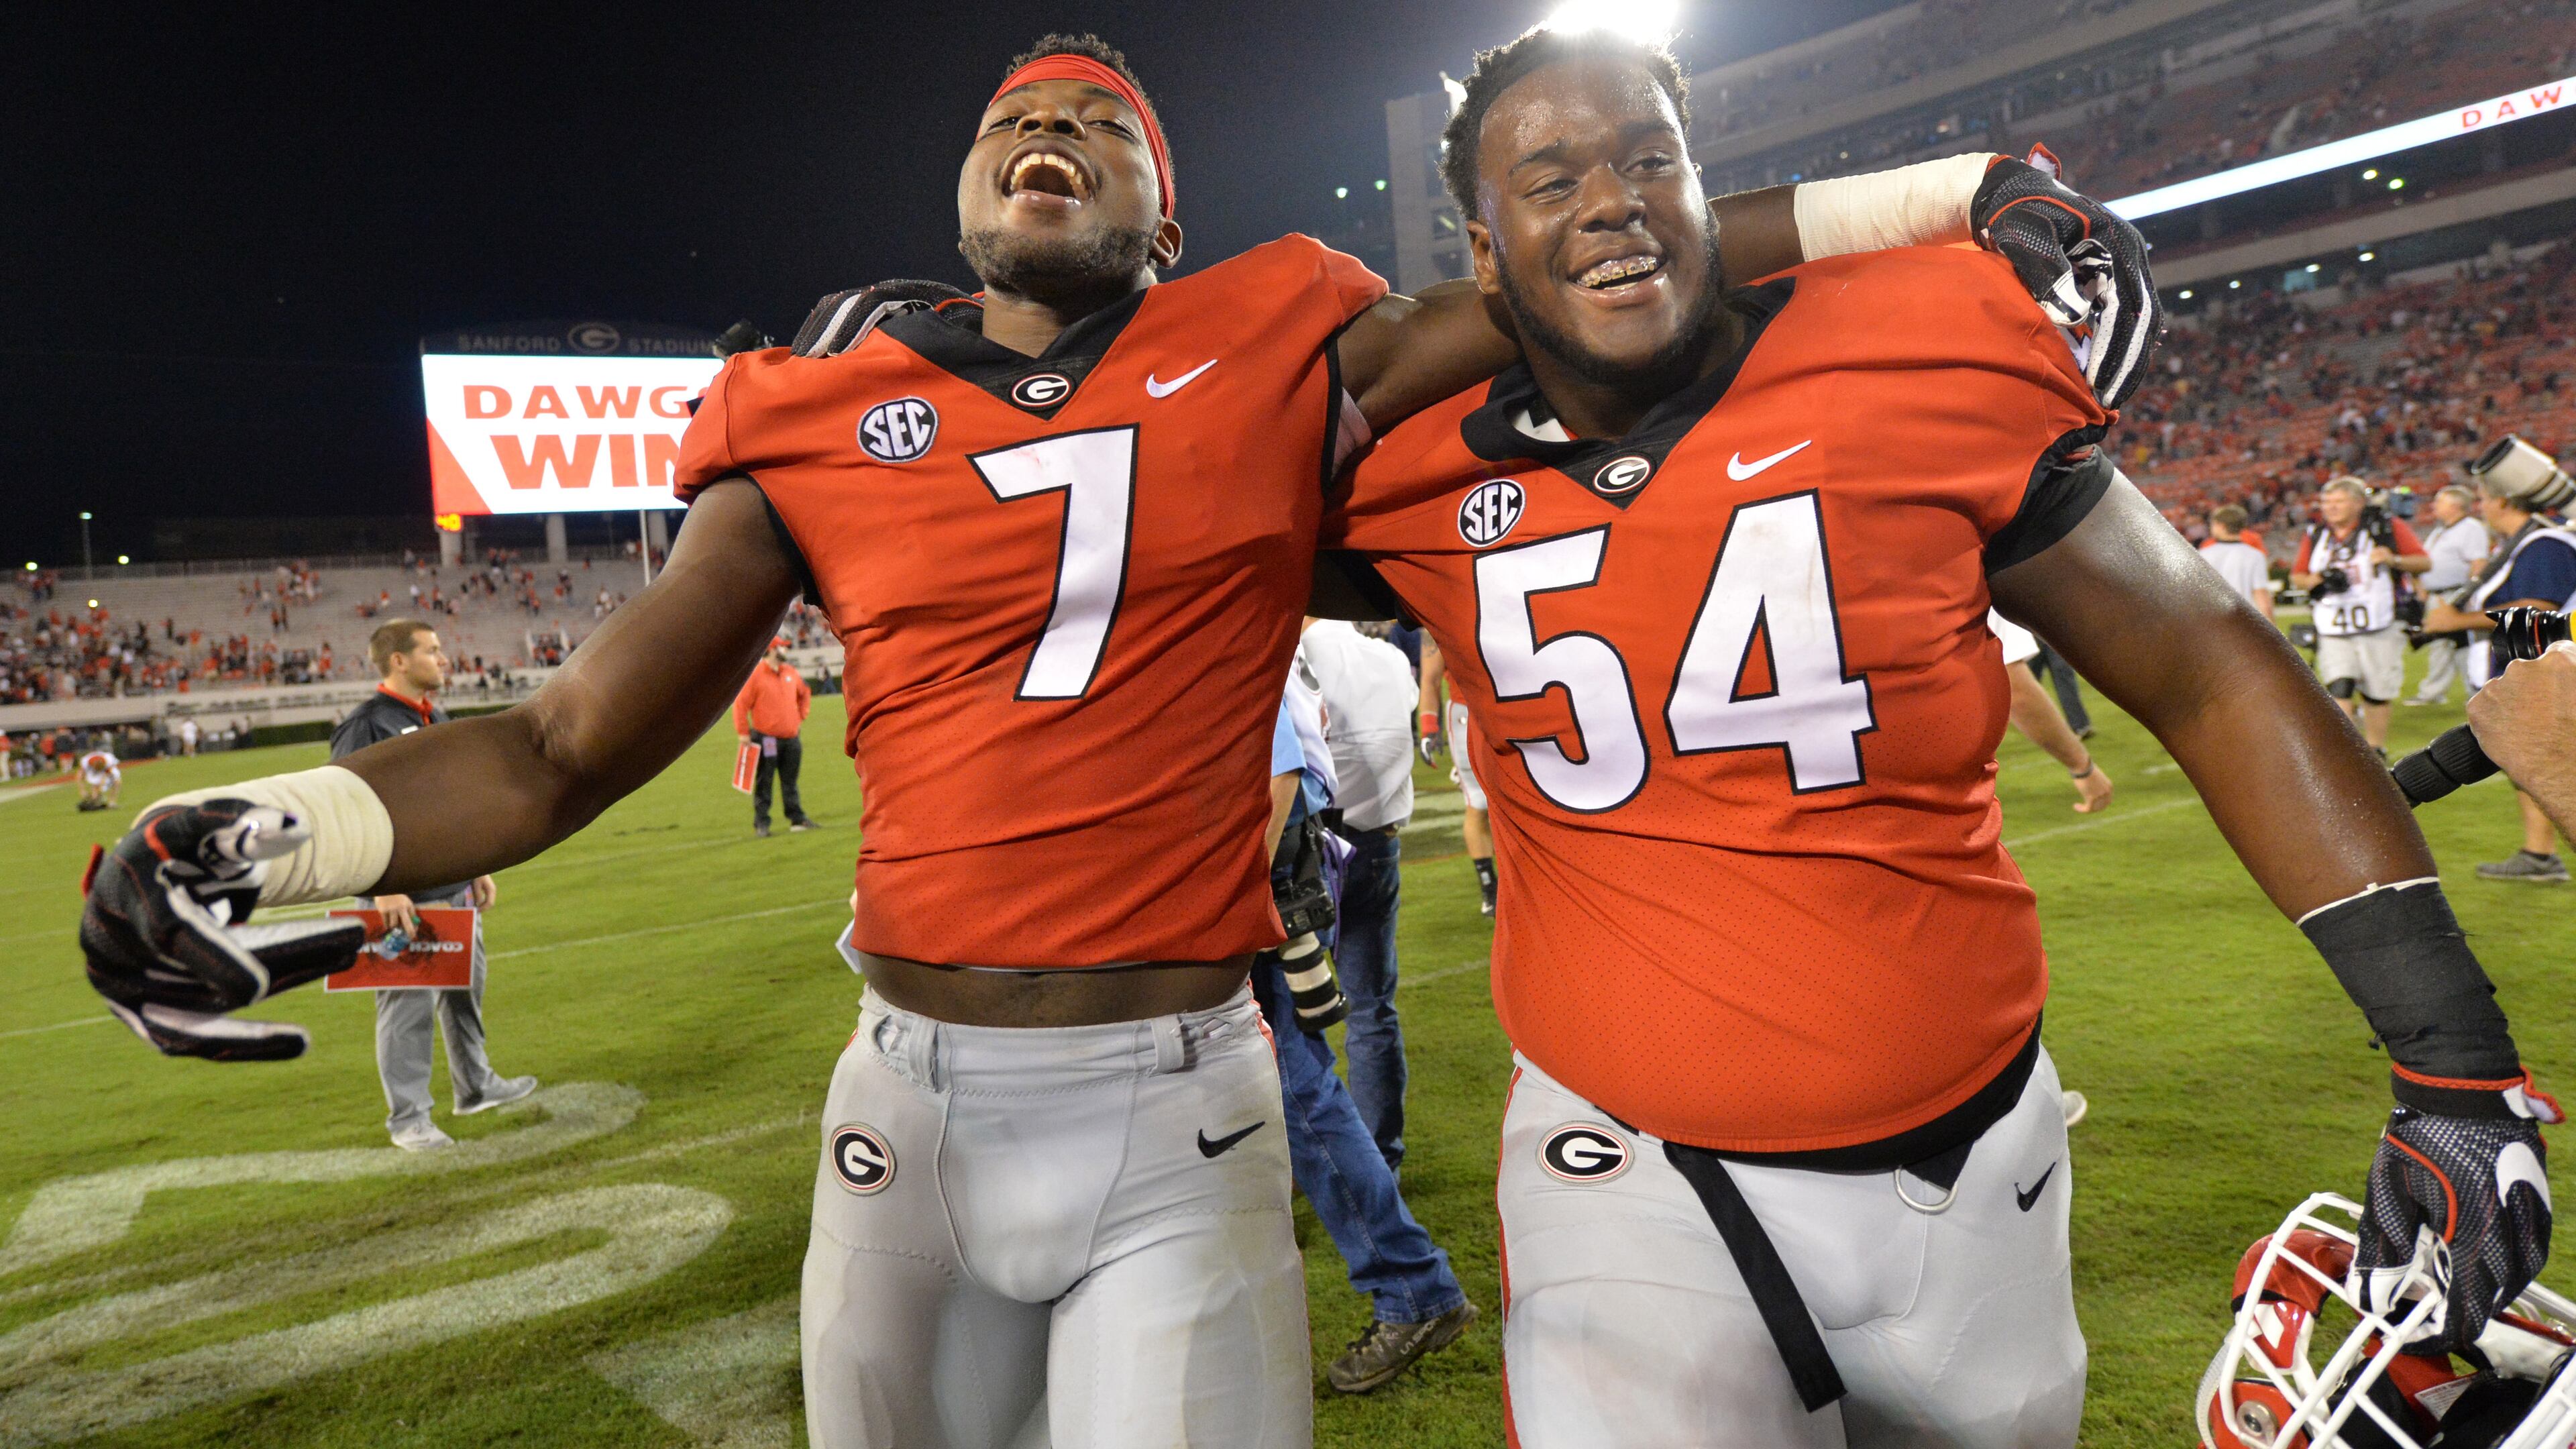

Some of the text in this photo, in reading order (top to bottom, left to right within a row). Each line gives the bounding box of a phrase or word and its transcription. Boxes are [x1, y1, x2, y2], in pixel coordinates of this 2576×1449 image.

[2461, 85, 2576, 127] DAW
[458, 334, 561, 353] SANFORD
[463, 384, 710, 419] DAWG
[863, 401, 931, 458] SEC
[1464, 480, 1521, 543] SEC
[964, 422, 1140, 701] 7
[2332, 605, 2369, 633] 40
[1472, 487, 1880, 814] 54
[409, 941, 464, 953] COACH
